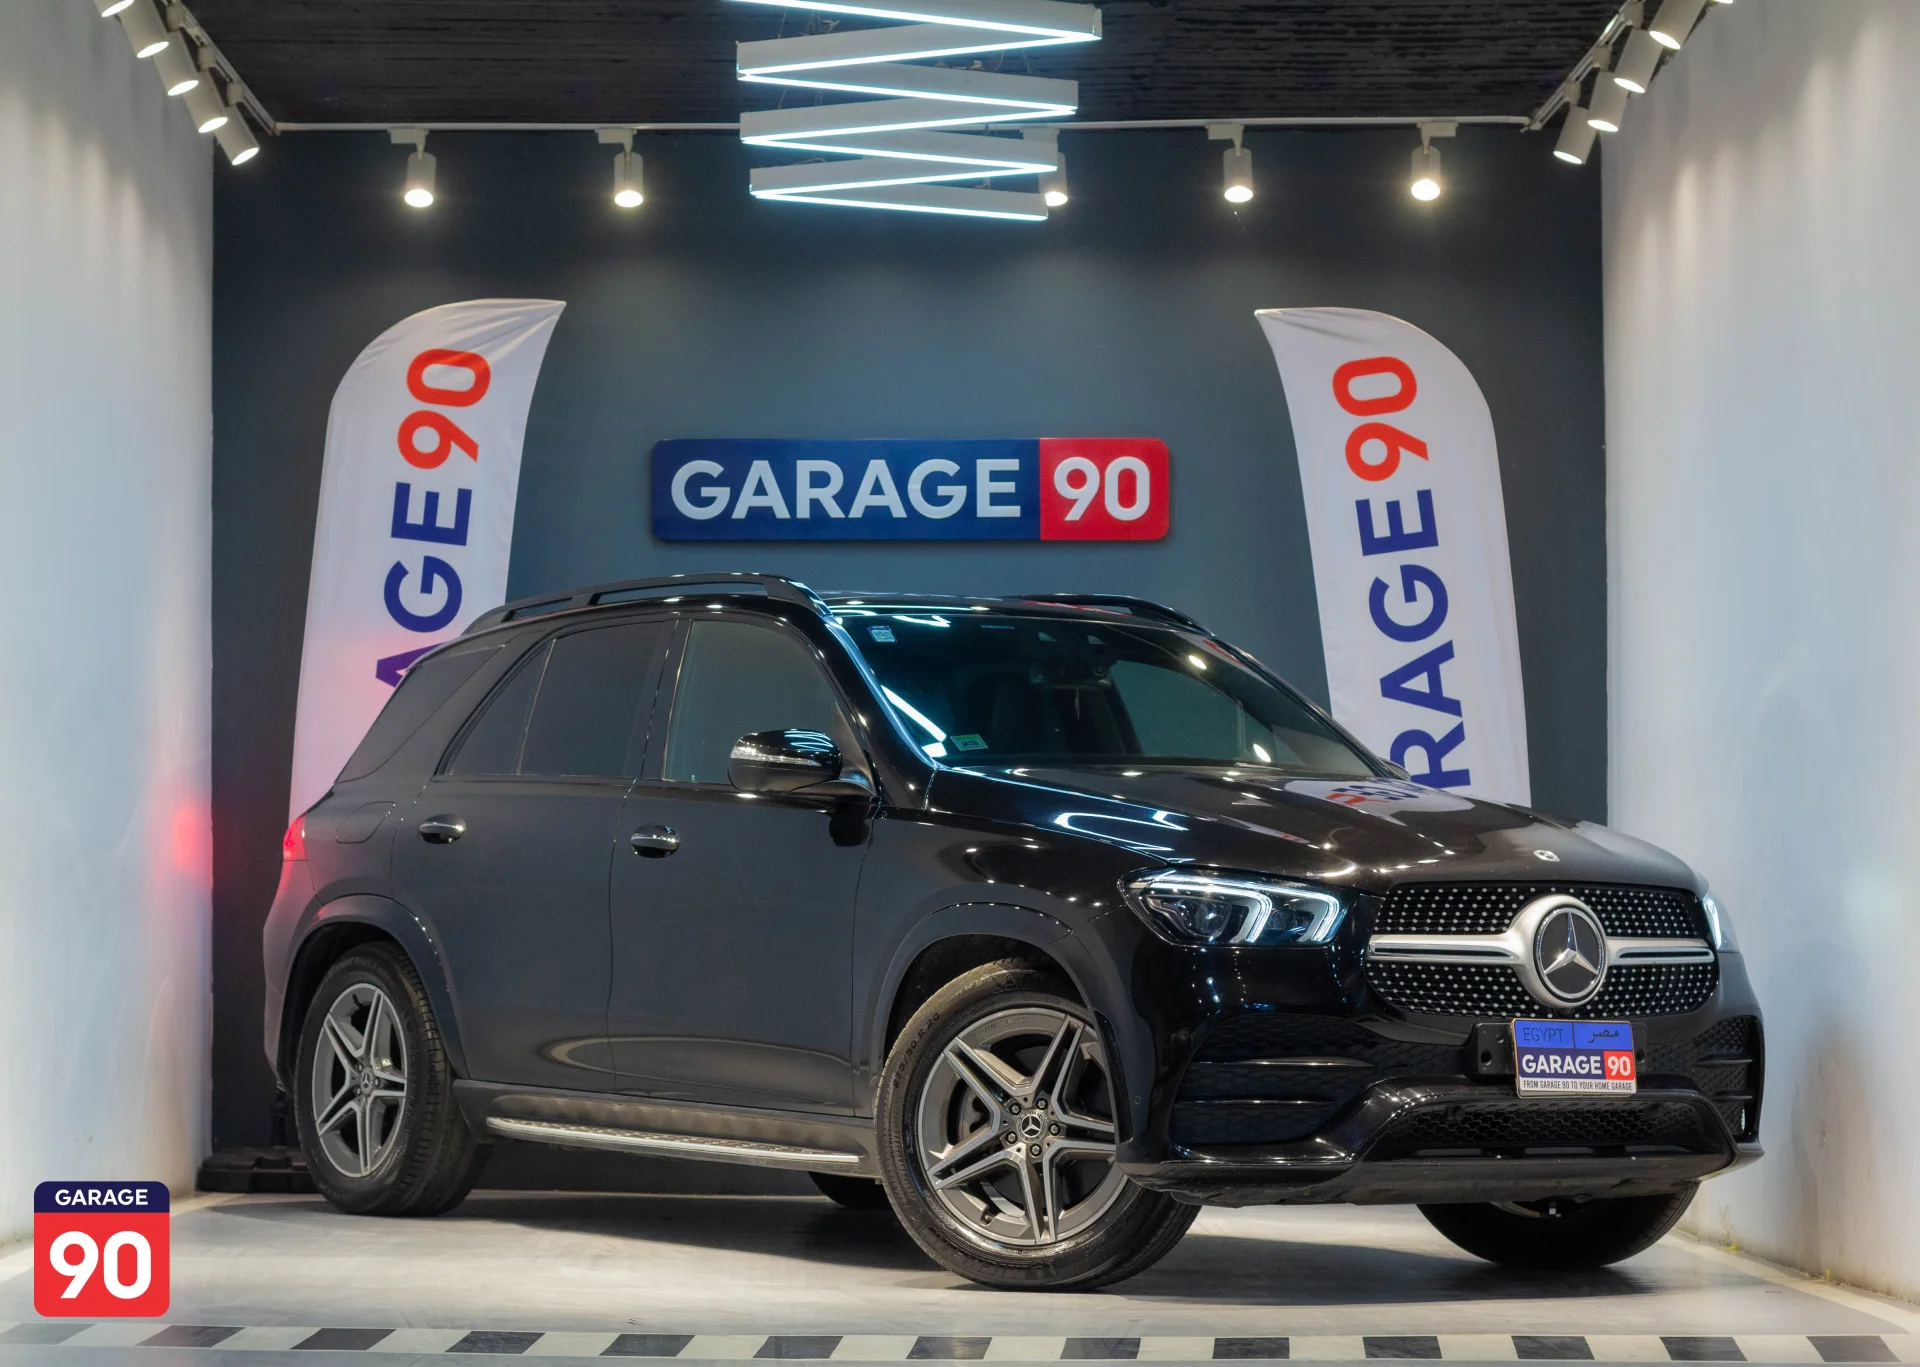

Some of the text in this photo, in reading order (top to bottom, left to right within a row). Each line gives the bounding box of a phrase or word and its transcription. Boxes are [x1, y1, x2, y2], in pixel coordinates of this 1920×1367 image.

[397, 348, 491, 469] 90
[671, 456, 1151, 522] GARAGE 90
[1332, 356, 1471, 789] RAGE 90
[1523, 1027, 1564, 1042] EGYPT
[1588, 1029, 1620, 1043] مصر
[1522, 1054, 1631, 1076] GARAGE 90
[1524, 1079, 1632, 1091] FROM GARAGE 90 TO YOUR HOME GARAGE
